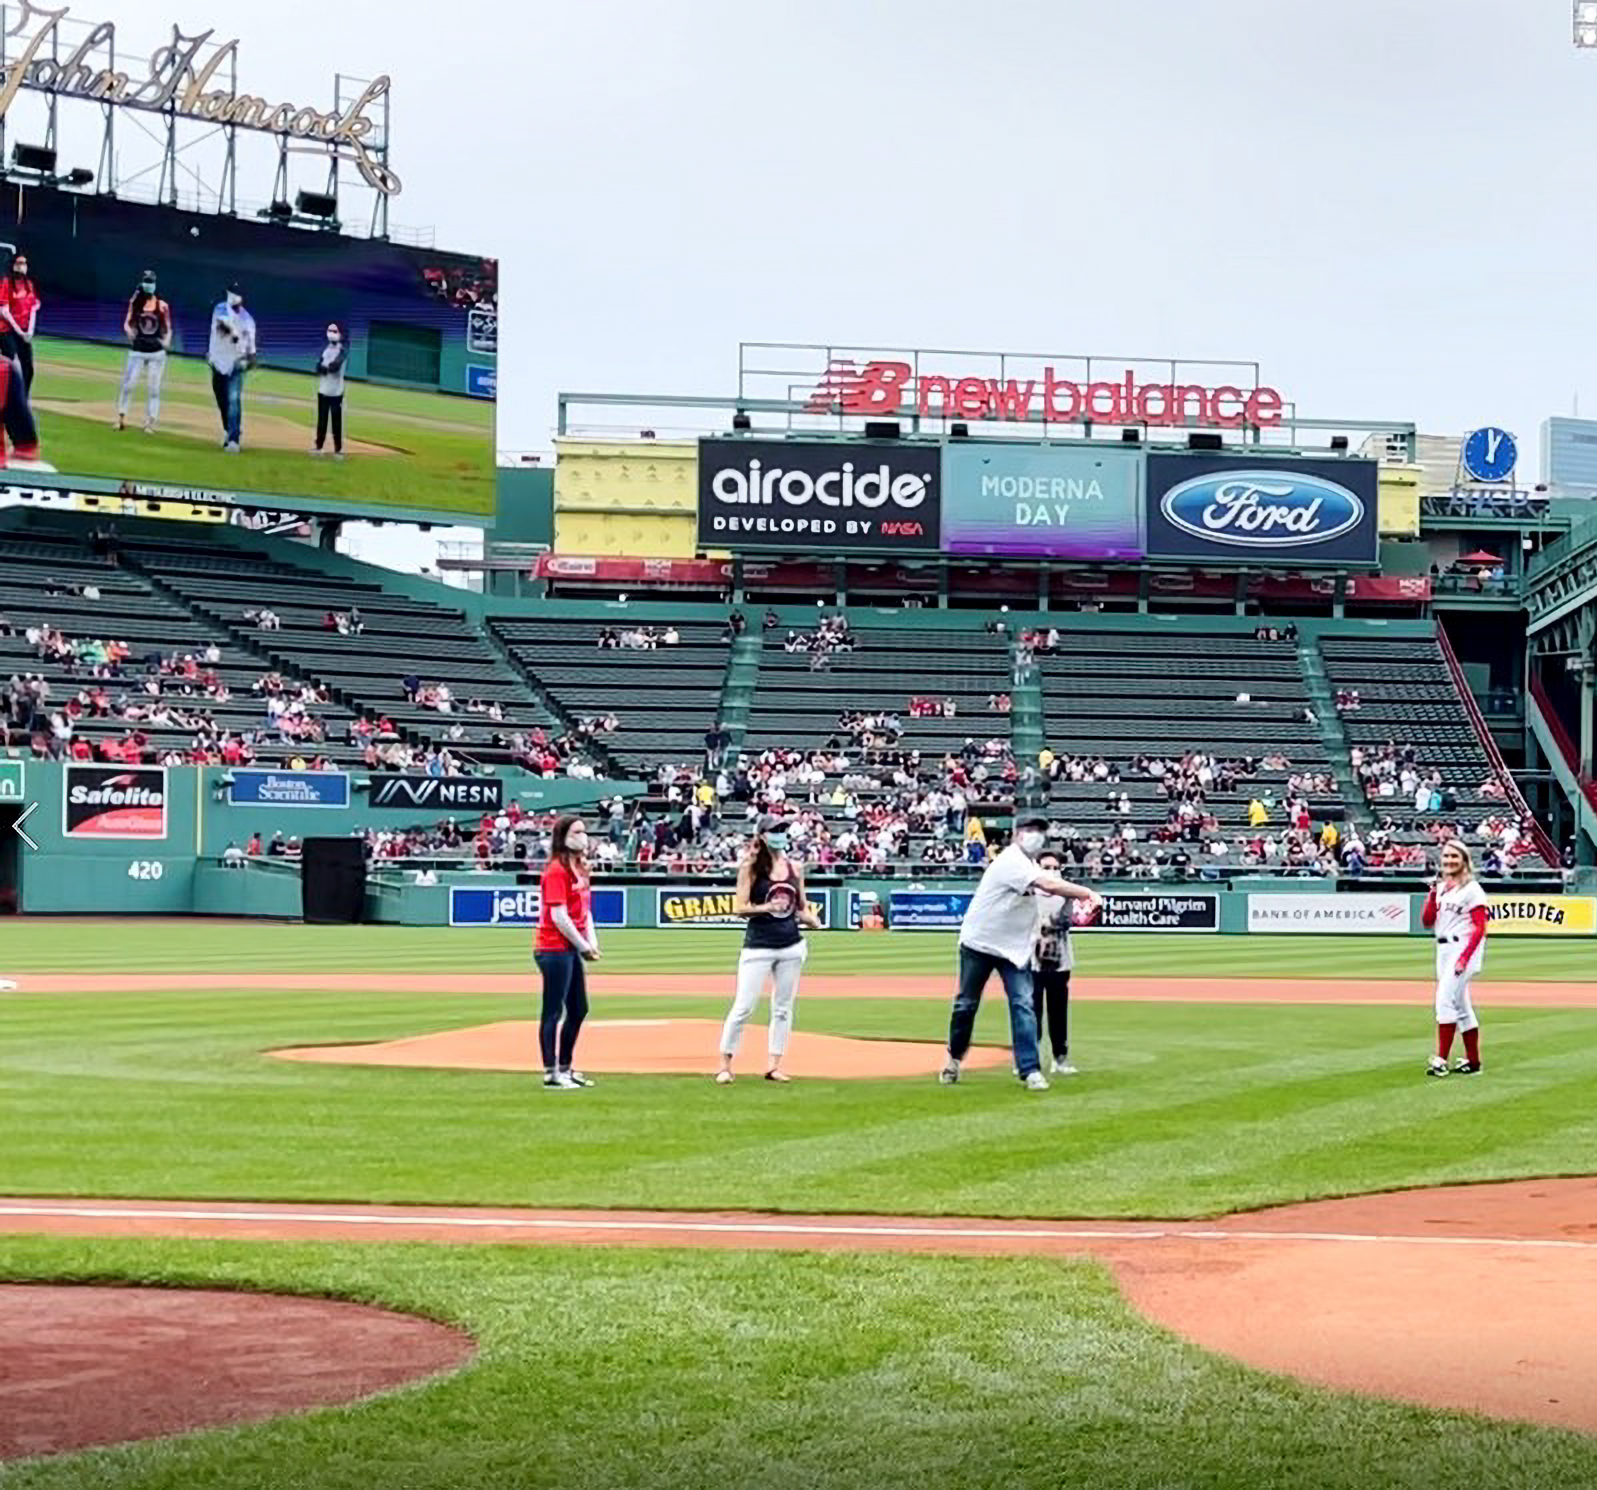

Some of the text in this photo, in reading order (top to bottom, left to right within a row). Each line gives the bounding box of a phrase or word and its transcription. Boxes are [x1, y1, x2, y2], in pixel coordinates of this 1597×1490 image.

[0, 0, 400, 194] John Hancock
[918, 374, 1037, 418] new
[1044, 367, 1283, 428] balance
[712, 459, 931, 508] airocide
[981, 476, 1103, 500] MODERNA
[1016, 504, 1069, 526] DAY
[1202, 480, 1325, 533] Ford
[713, 517, 923, 535] DEVELOPED BY NASA
[69, 785, 163, 806] Safelite
[440, 784, 498, 804] NESN
[128, 860, 163, 880] 420
[490, 890, 541, 924] jetB
[663, 894, 737, 919] GRAN
[1101, 897, 1207, 914] Harvard Pilgrim
[1252, 909, 1376, 920] BANK OF AMERICA
[1538, 903, 1565, 925] TEA
[1101, 911, 1181, 926] Health Care
